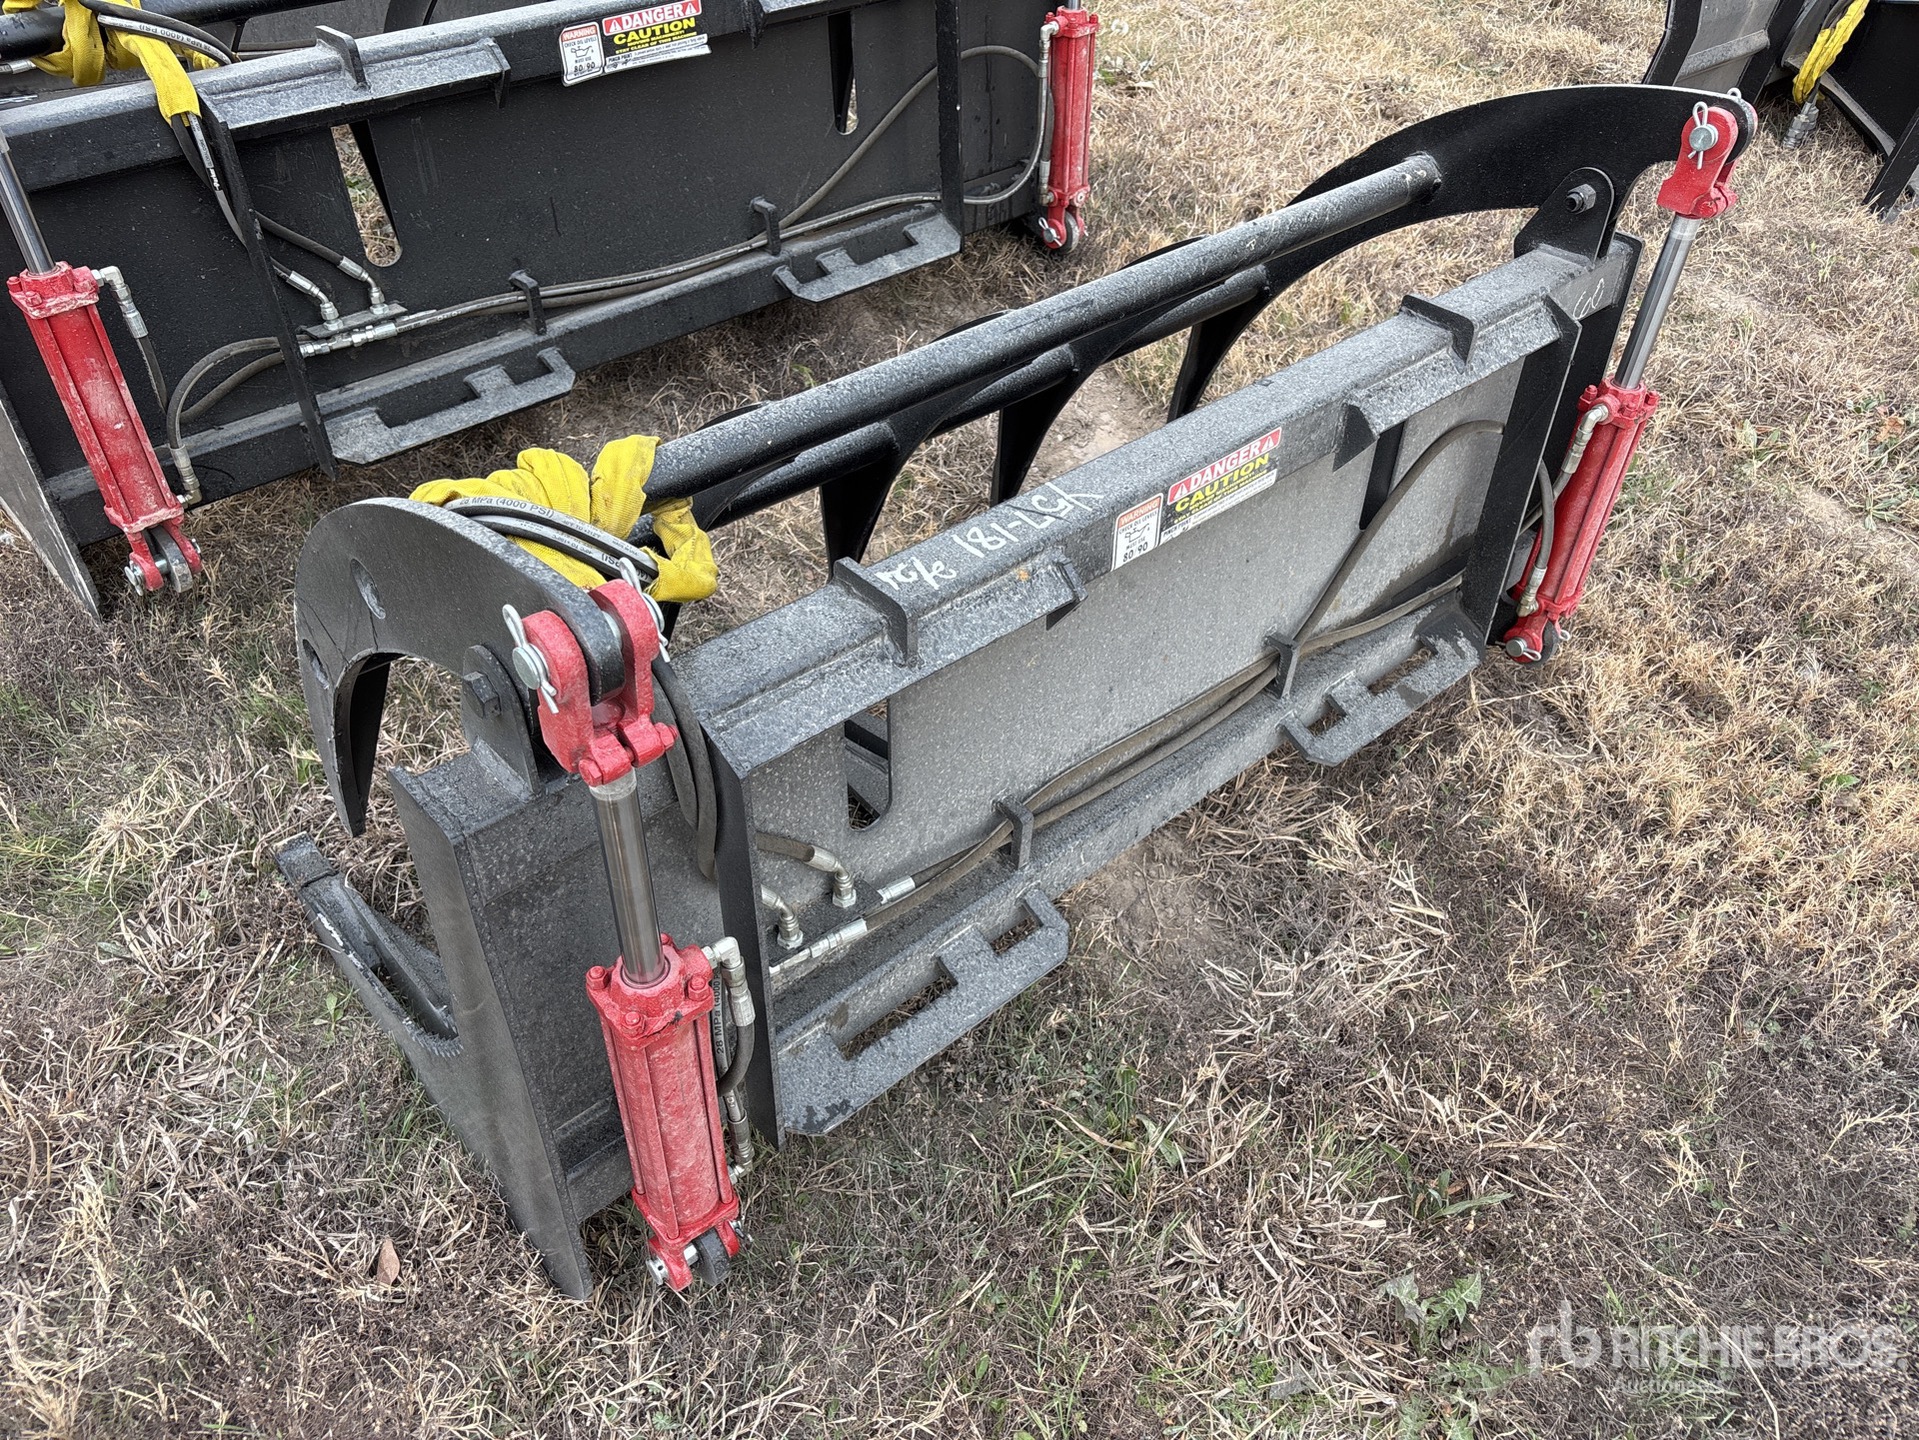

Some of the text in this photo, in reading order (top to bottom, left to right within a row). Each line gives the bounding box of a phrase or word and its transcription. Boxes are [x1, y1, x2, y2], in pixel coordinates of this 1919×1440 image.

[621, 3, 684, 30] DANGER
[563, 28, 596, 41] WARNING
[613, 17, 696, 45] CAUTION
[631, 43, 649, 51] CLEAR
[672, 31, 697, 41] MACHINE
[1189, 441, 1260, 492] DANGER
[1175, 453, 1269, 512] CAUTION
[471, 497, 494, 506] MPa
[495, 497, 528, 510] (4000
[530, 504, 555, 520] PSI)
[1121, 502, 1158, 525] WARNING
[713, 980, 722, 1007] (4000
[713, 1010, 723, 1037] MPa
[716, 1040, 724, 1055] 28
